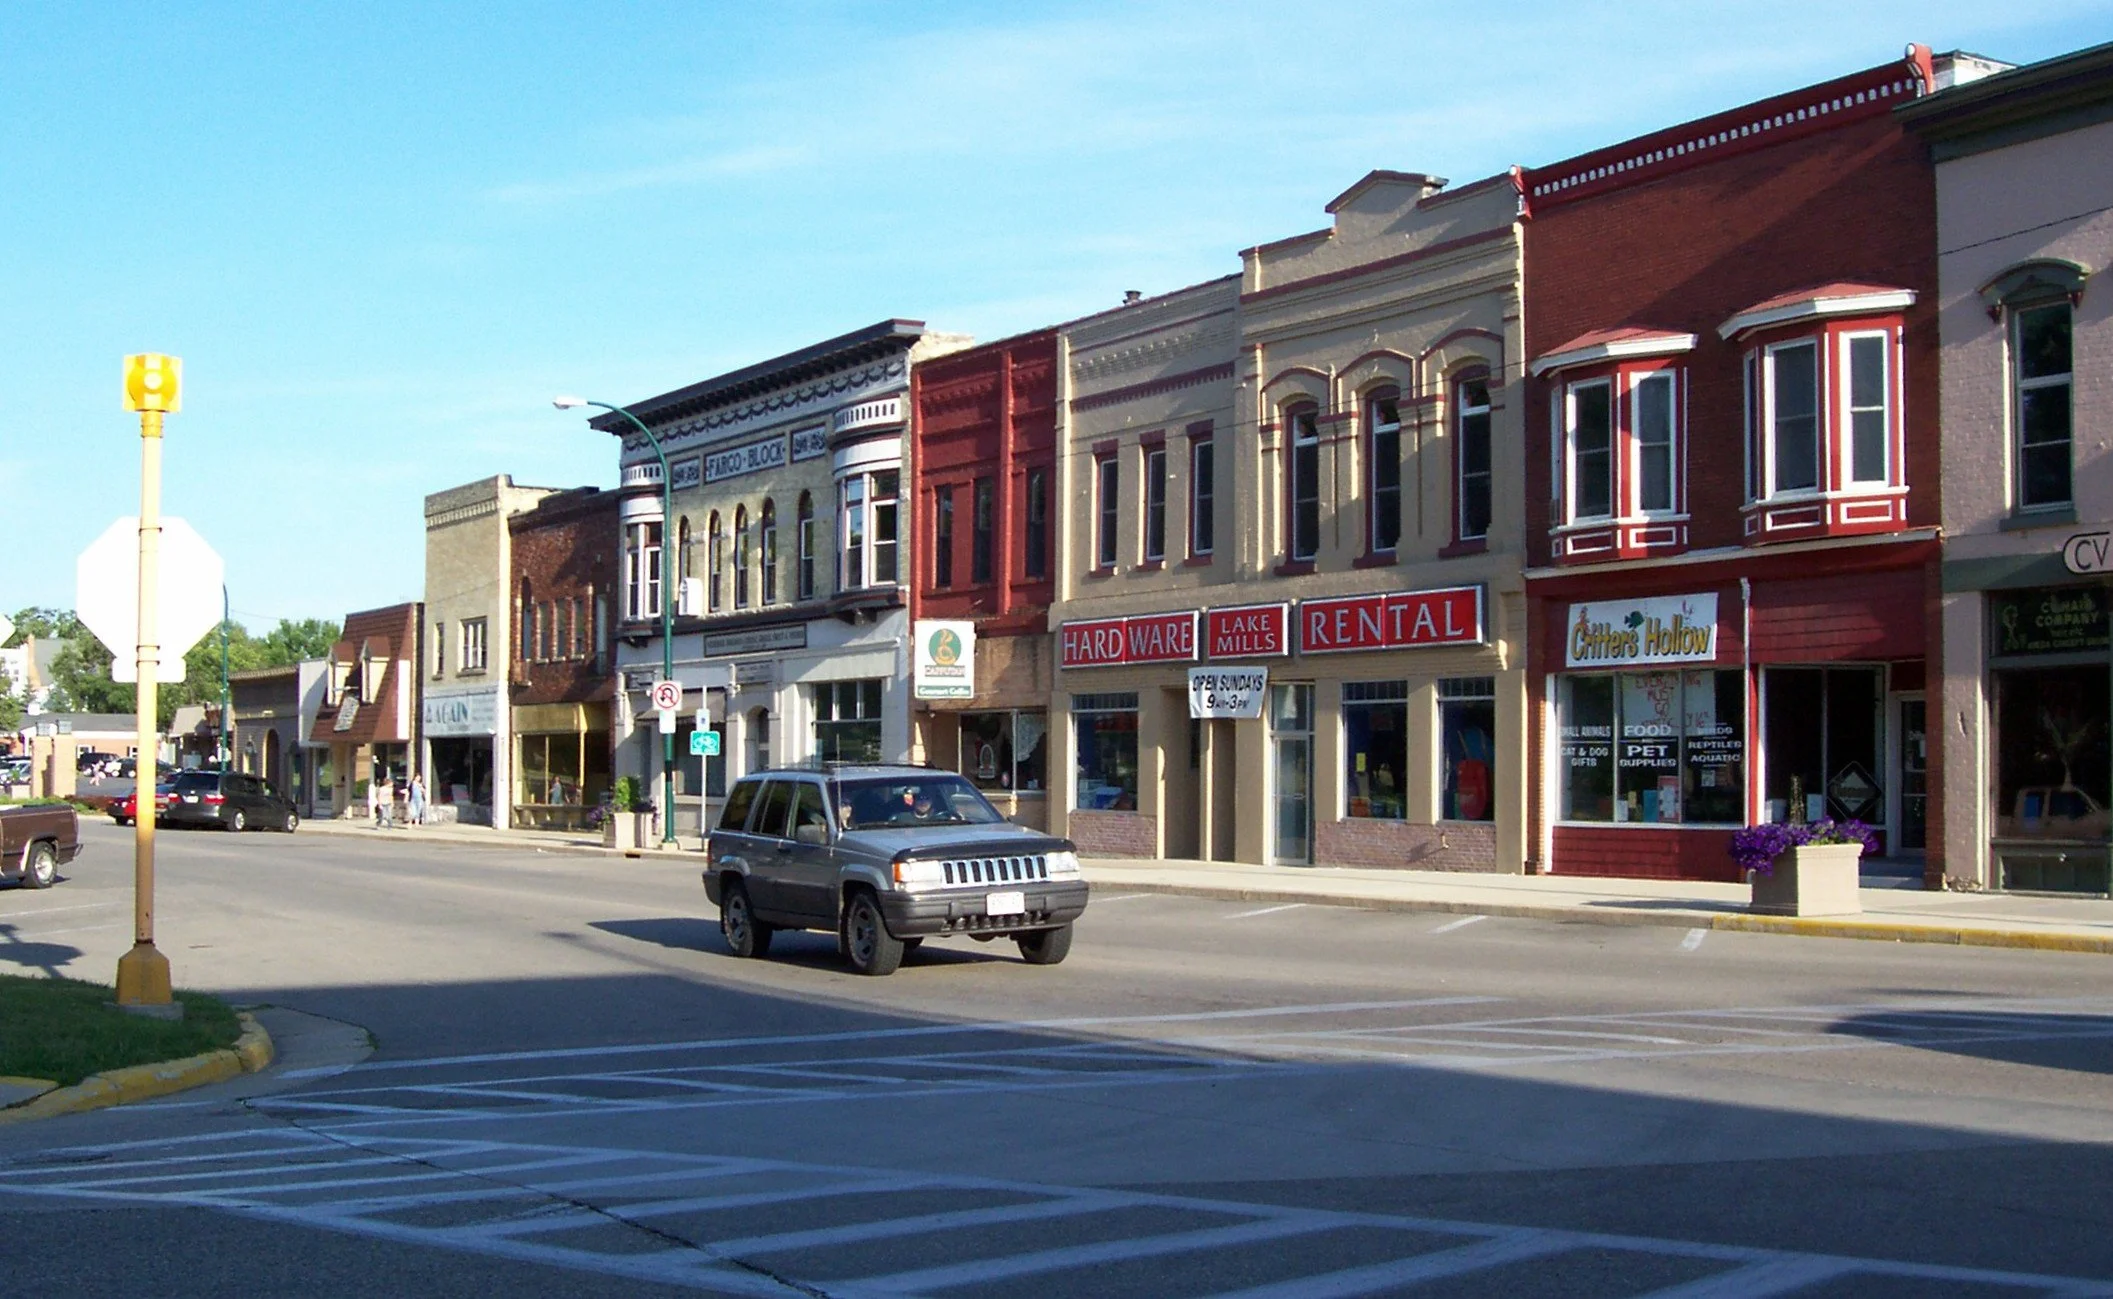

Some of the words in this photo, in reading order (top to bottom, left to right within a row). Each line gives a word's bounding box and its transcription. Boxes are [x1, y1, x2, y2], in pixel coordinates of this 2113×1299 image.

[748, 442, 784, 468] BLOCK
[1221, 614, 1271, 635] LAKE
[1310, 600, 1464, 645] RENTAL
[2035, 611, 2099, 628] COMPANY
[1063, 620, 1193, 662] HARDWARE
[1216, 633, 1276, 653] MILLS
[1571, 622, 1639, 661] Critters
[1644, 613, 1711, 657] Hollow
[1193, 674, 1218, 693] OPEN
[1218, 674, 1264, 693] SUNDAYS
[1624, 724, 1672, 737] FOOD
[1589, 747, 1609, 757] DOG
[1627, 745, 1669, 757] PET
[1571, 757, 1597, 767] GIFTS
[1619, 758, 1677, 767] SUPPLIES
